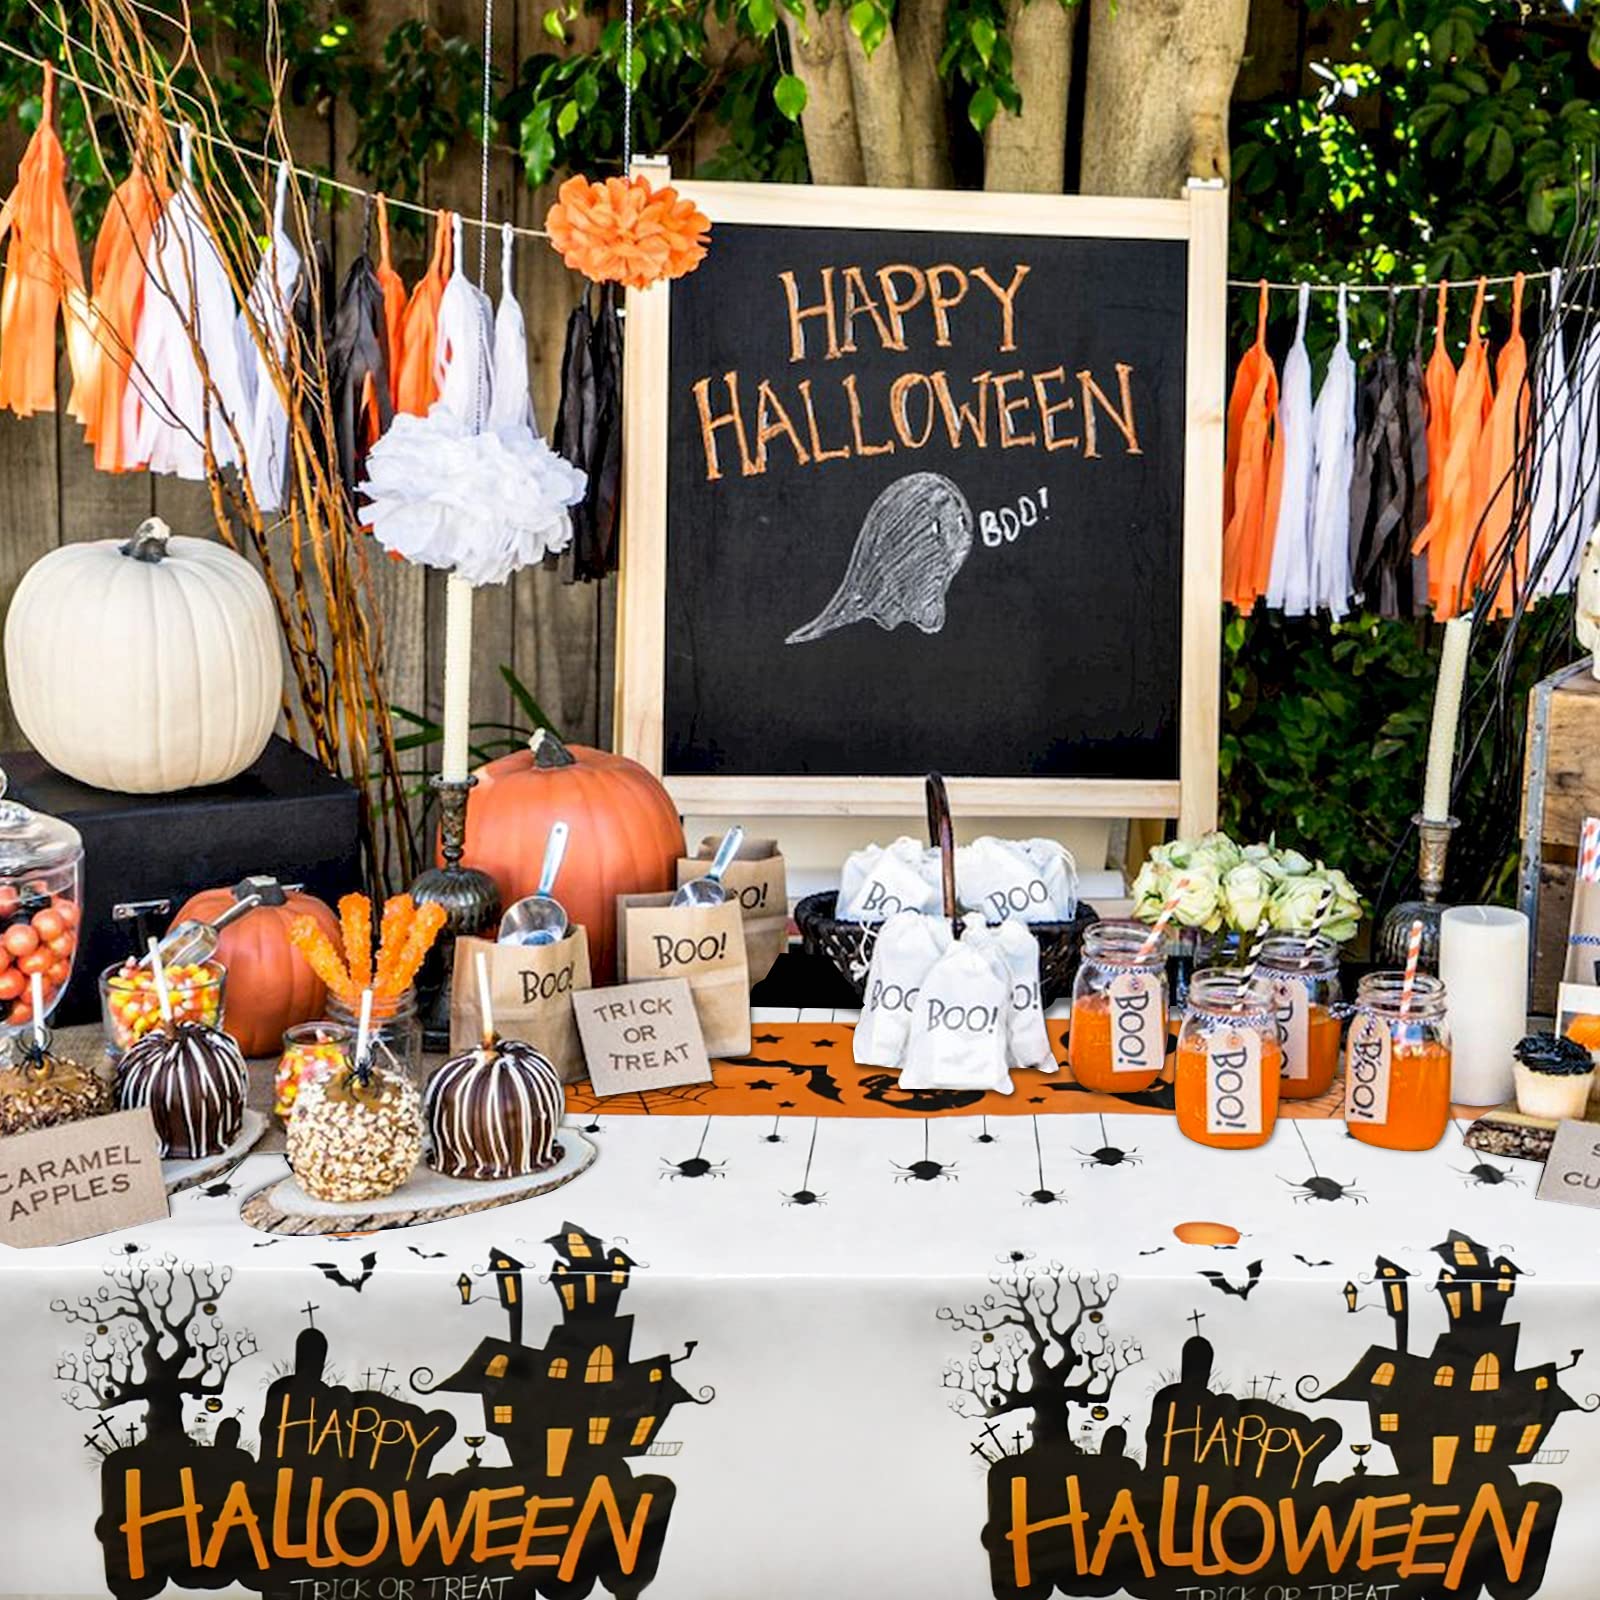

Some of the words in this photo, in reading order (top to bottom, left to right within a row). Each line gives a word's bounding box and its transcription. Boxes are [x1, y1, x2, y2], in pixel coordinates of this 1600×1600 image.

[778, 263, 1031, 363] HAPPY
[692, 362, 1144, 481] HALLOWEEN
[979, 487, 1050, 547] BOO!
[862, 880, 921, 917] BO
[653, 932, 727, 968] BOO!
[518, 962, 576, 1004] BOO!
[593, 998, 673, 1024] TRICK
[623, 1025, 657, 1044] OR
[927, 998, 999, 1034] BOO!
[608, 1043, 690, 1072] TREAT
[0, 1145, 141, 1195] CARAMEL
[8, 1173, 131, 1222] APPLES
[277, 1393, 441, 1482] HAPPY
[1163, 1402, 1326, 1489] HAPPY
[119, 1466, 653, 1583] HALLOWEEN
[1006, 1474, 1540, 1592] HALLOWEEN
[289, 1577, 372, 1600] TRICK
[378, 1576, 416, 1600] OR
[422, 1574, 514, 1600] TREAT
